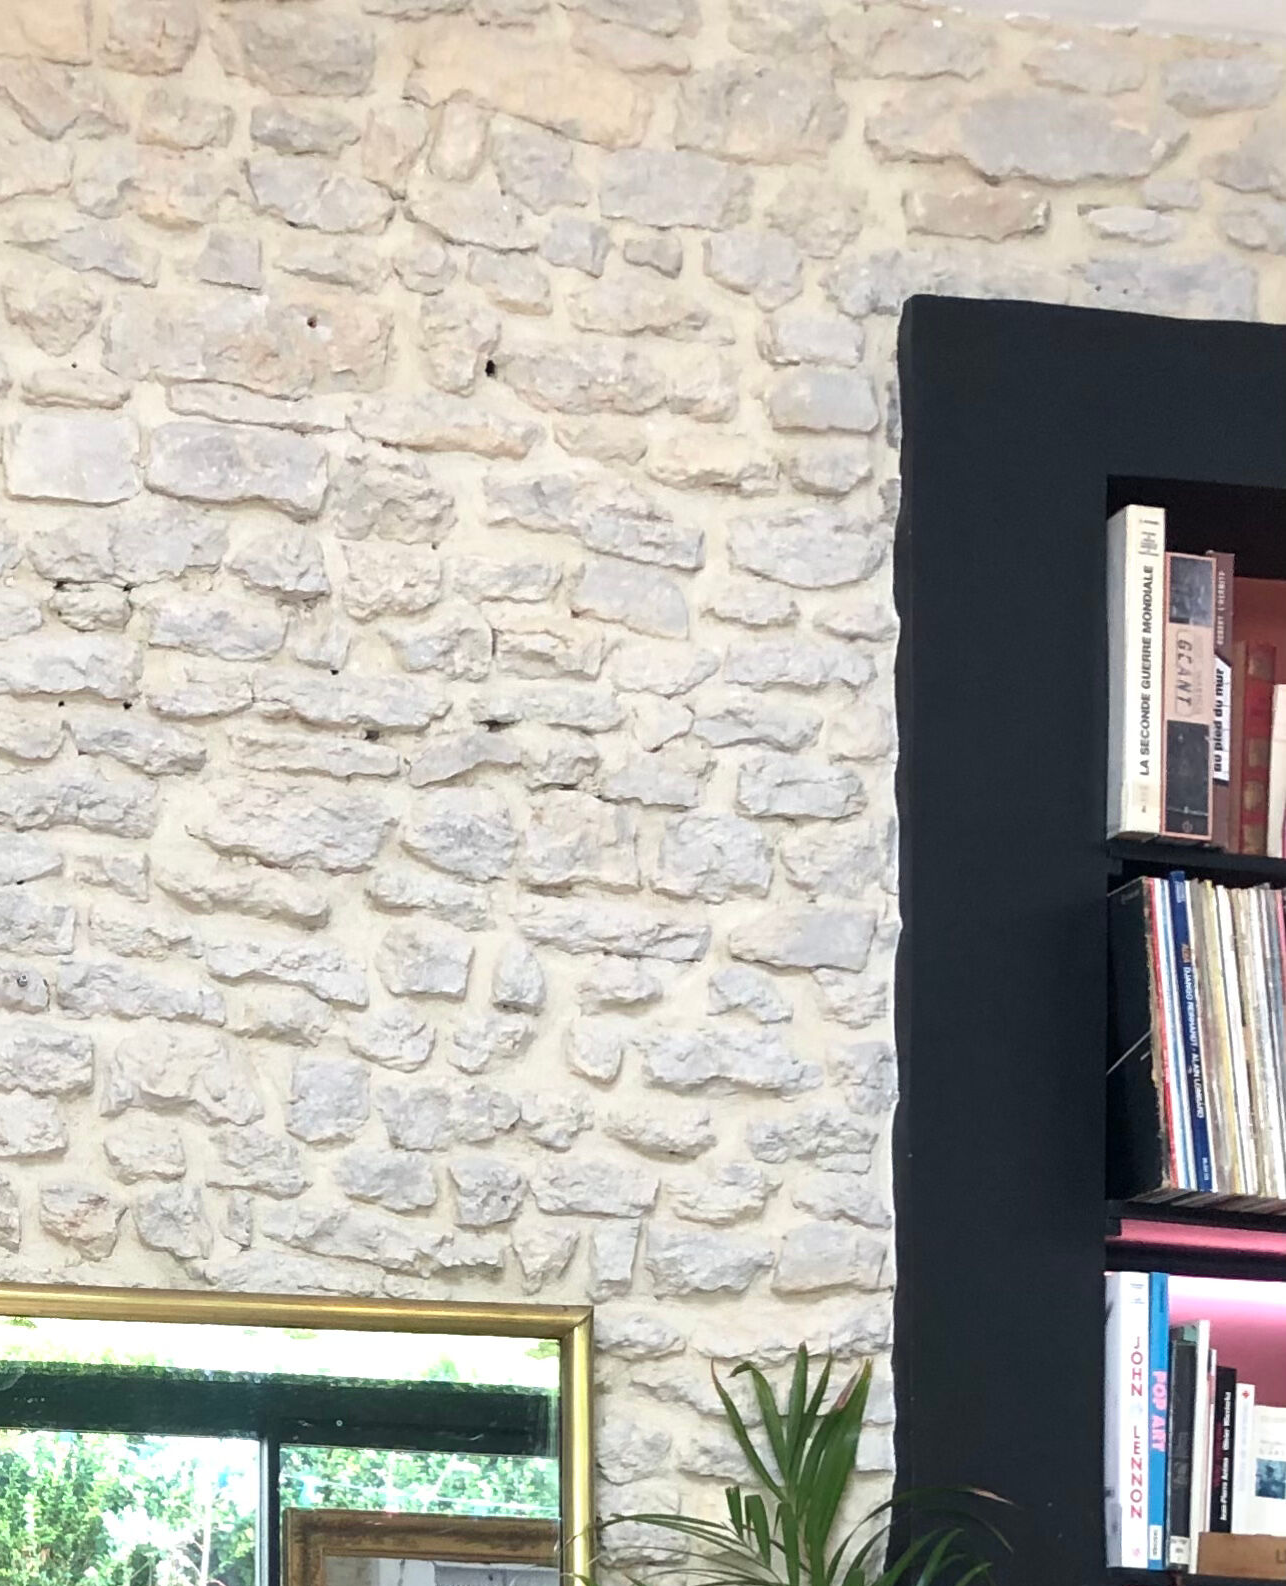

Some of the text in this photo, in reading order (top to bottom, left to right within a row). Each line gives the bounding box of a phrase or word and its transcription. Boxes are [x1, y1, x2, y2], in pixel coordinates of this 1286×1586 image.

[1142, 565, 1154, 634] MONDIALE
[1141, 636, 1152, 689] GUERRE
[1215, 668, 1225, 696] mur
[1140, 693, 1151, 755] SECONDE
[1213, 700, 1223, 717] du
[1139, 760, 1150, 776] LA
[1183, 966, 1193, 1000] DJANGO
[1130, 1336, 1143, 1519] JOHN LENNON
[1151, 1371, 1167, 1452] POP ART
